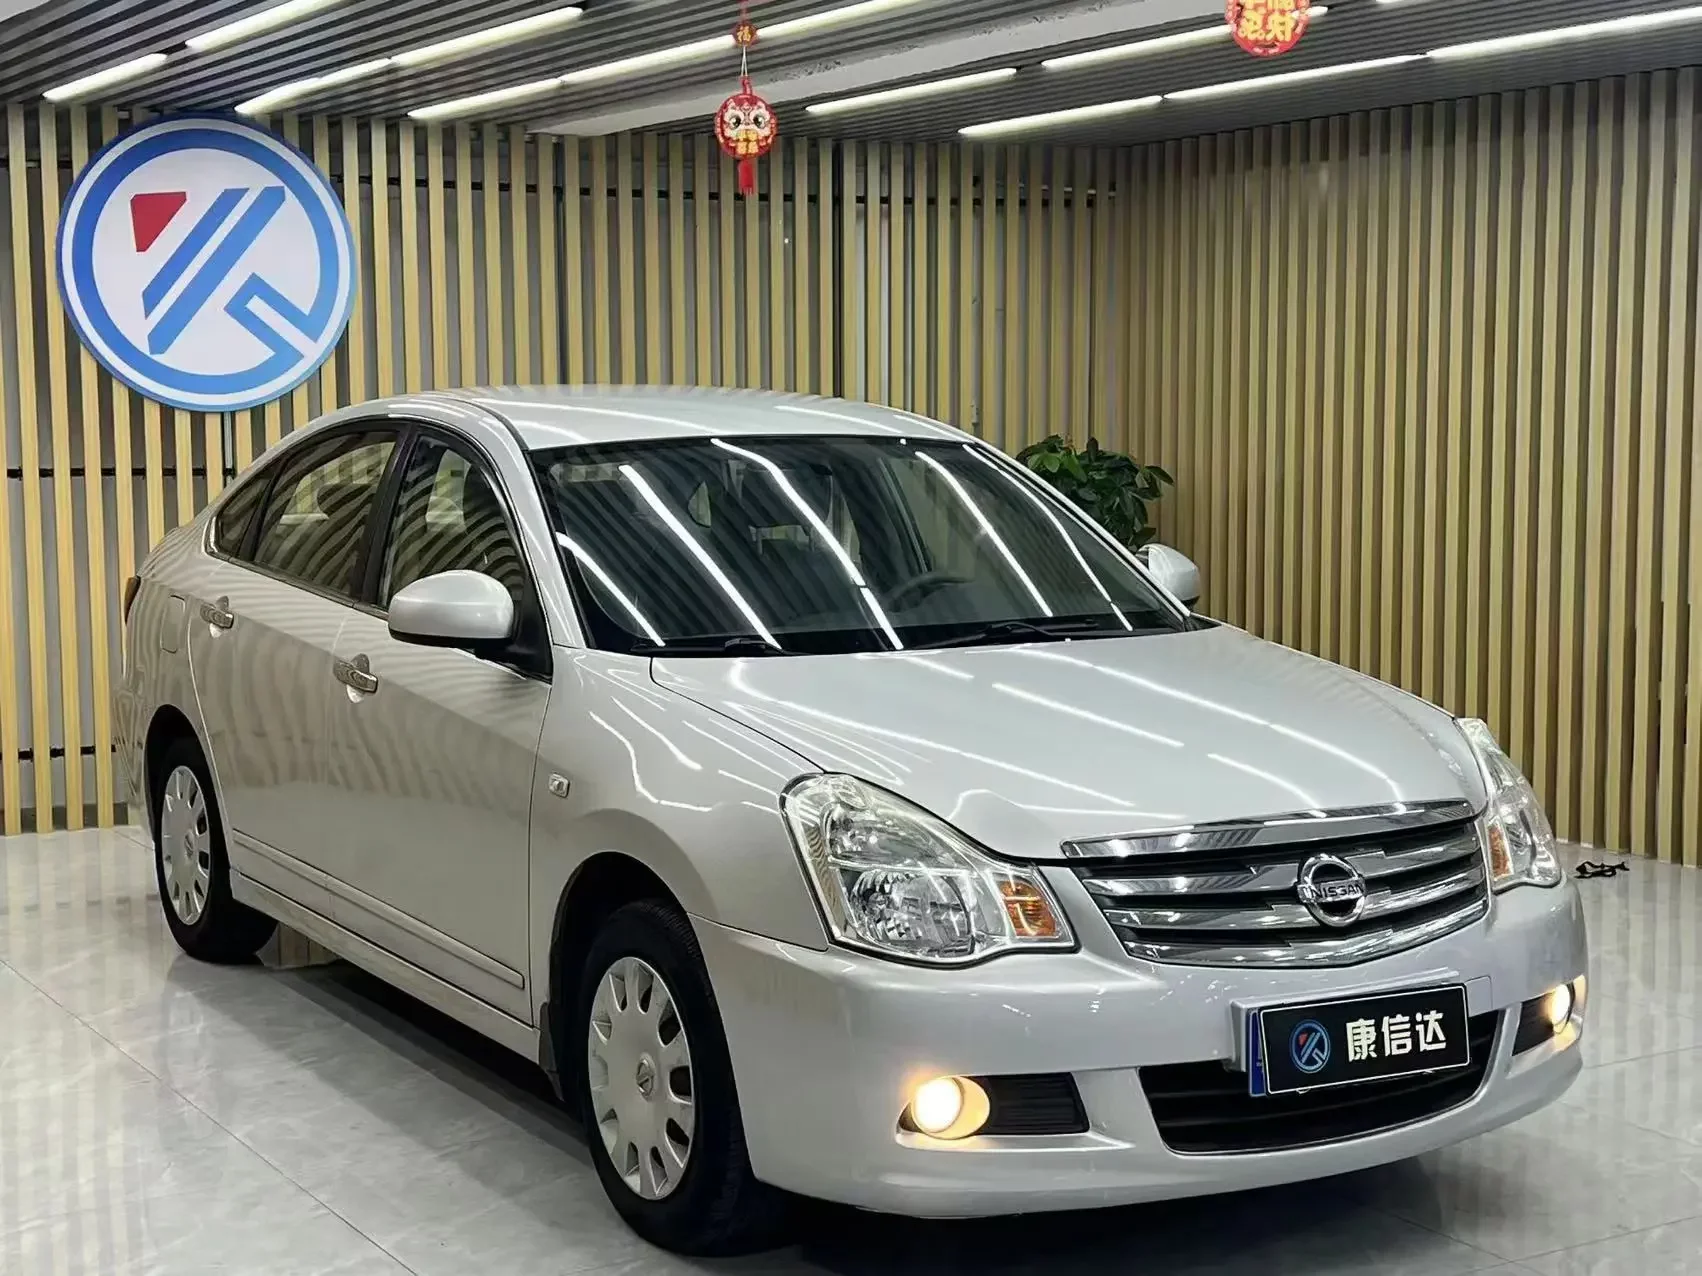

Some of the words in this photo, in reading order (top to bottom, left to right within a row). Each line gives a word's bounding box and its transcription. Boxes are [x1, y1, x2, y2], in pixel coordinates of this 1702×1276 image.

[1311, 883, 1364, 899] NISSAN
[1346, 1009, 1447, 1062] 康信达
